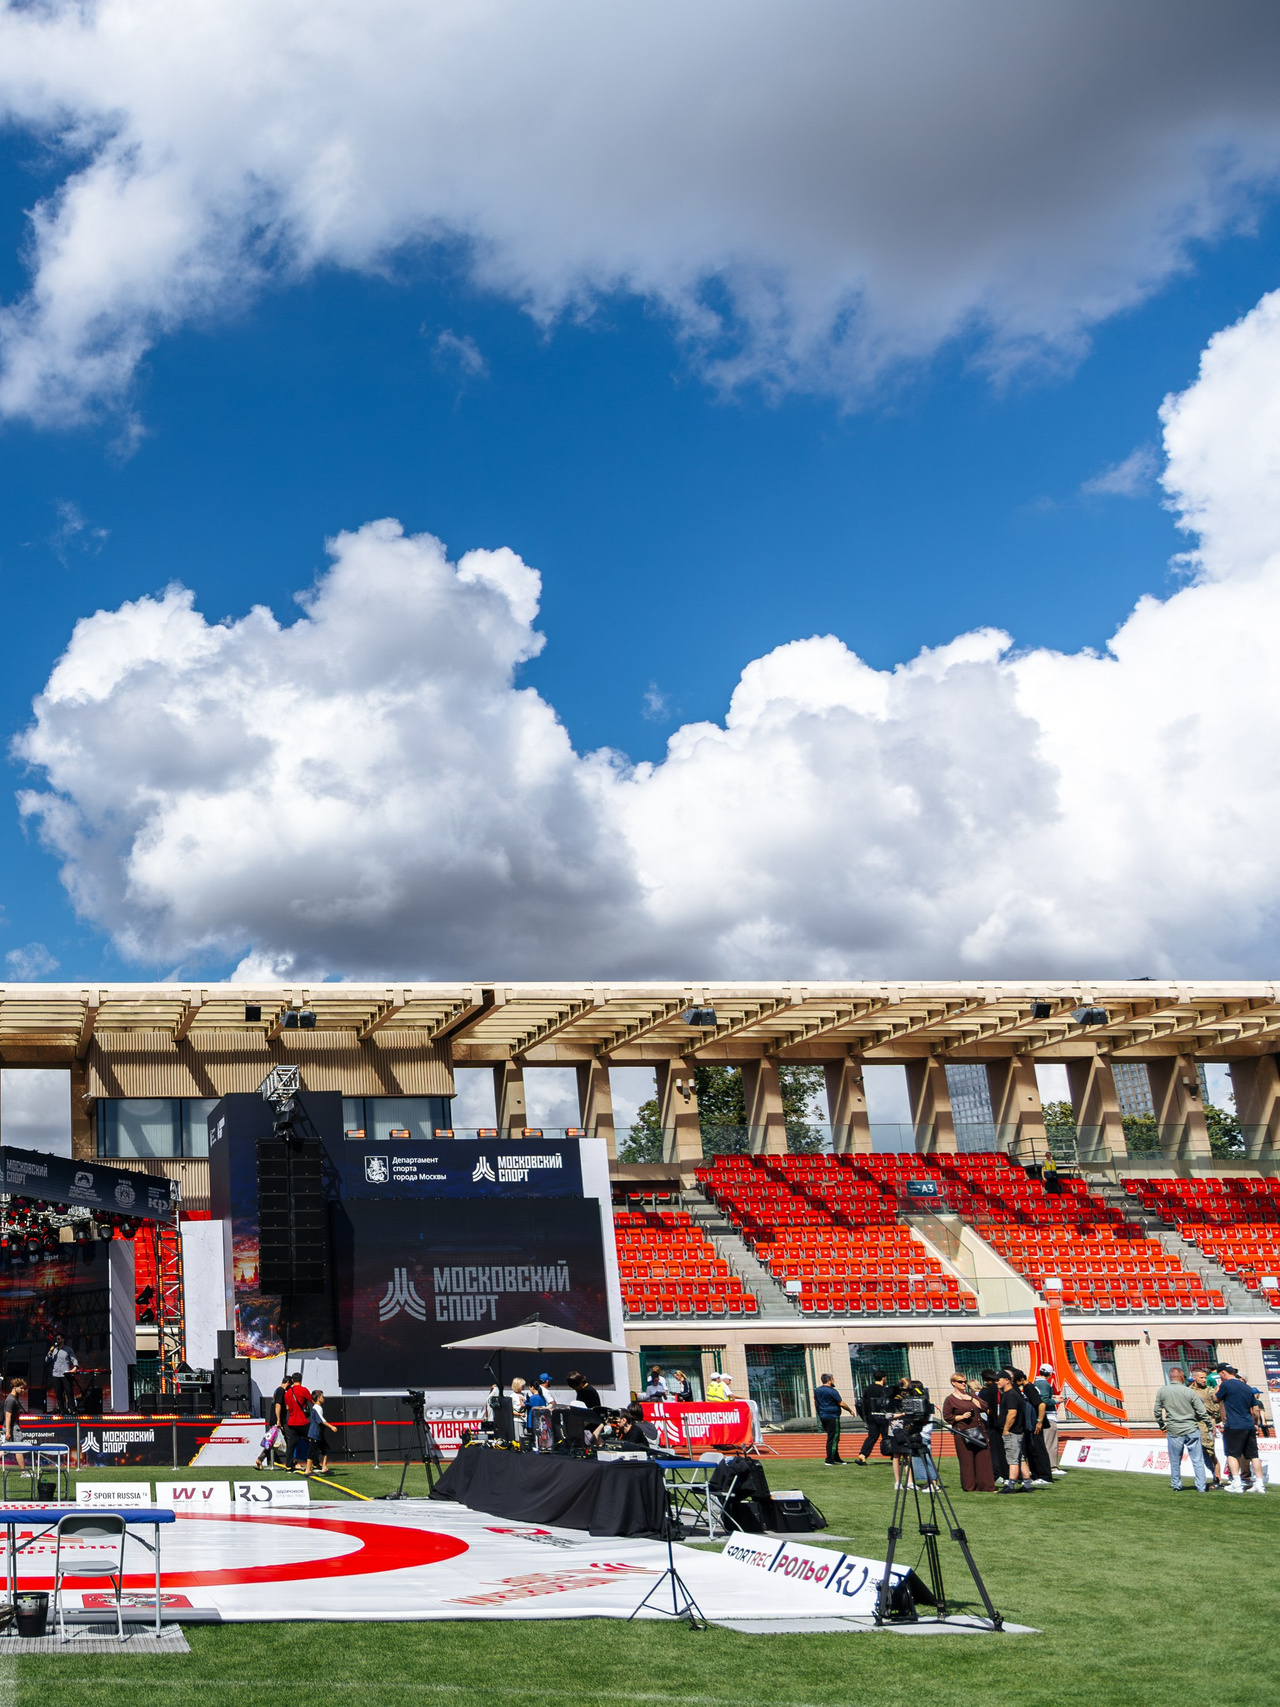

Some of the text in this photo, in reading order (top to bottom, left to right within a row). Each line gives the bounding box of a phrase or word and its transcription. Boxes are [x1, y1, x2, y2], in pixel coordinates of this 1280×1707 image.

[392, 1156, 439, 1165] Департамент
[497, 1153, 563, 1169] МОСКОВСКИЙ
[6, 1159, 48, 1177] МОСКОВСКИЙ
[393, 1165, 417, 1173] спорта
[6, 1171, 26, 1185] СПОРТ
[393, 1173, 447, 1182] города Москвы
[498, 1169, 529, 1182] СПОРТ
[433, 1260, 570, 1292] МОСКОВСКИЙ
[435, 1295, 499, 1321] СПОРТ
[680, 1409, 740, 1425] МОСКОВСКИЙ
[102, 1429, 155, 1442] МОСКОВСКИЙ
[682, 1425, 710, 1438] СПОРТ
[102, 1442, 128, 1453] СПОРТ
[94, 1492, 115, 1500] SPORT
[117, 1492, 141, 1500] RUSSIA
[727, 1545, 772, 1568] SPORTREC
[774, 1555, 829, 1583] РОЛЬФ
